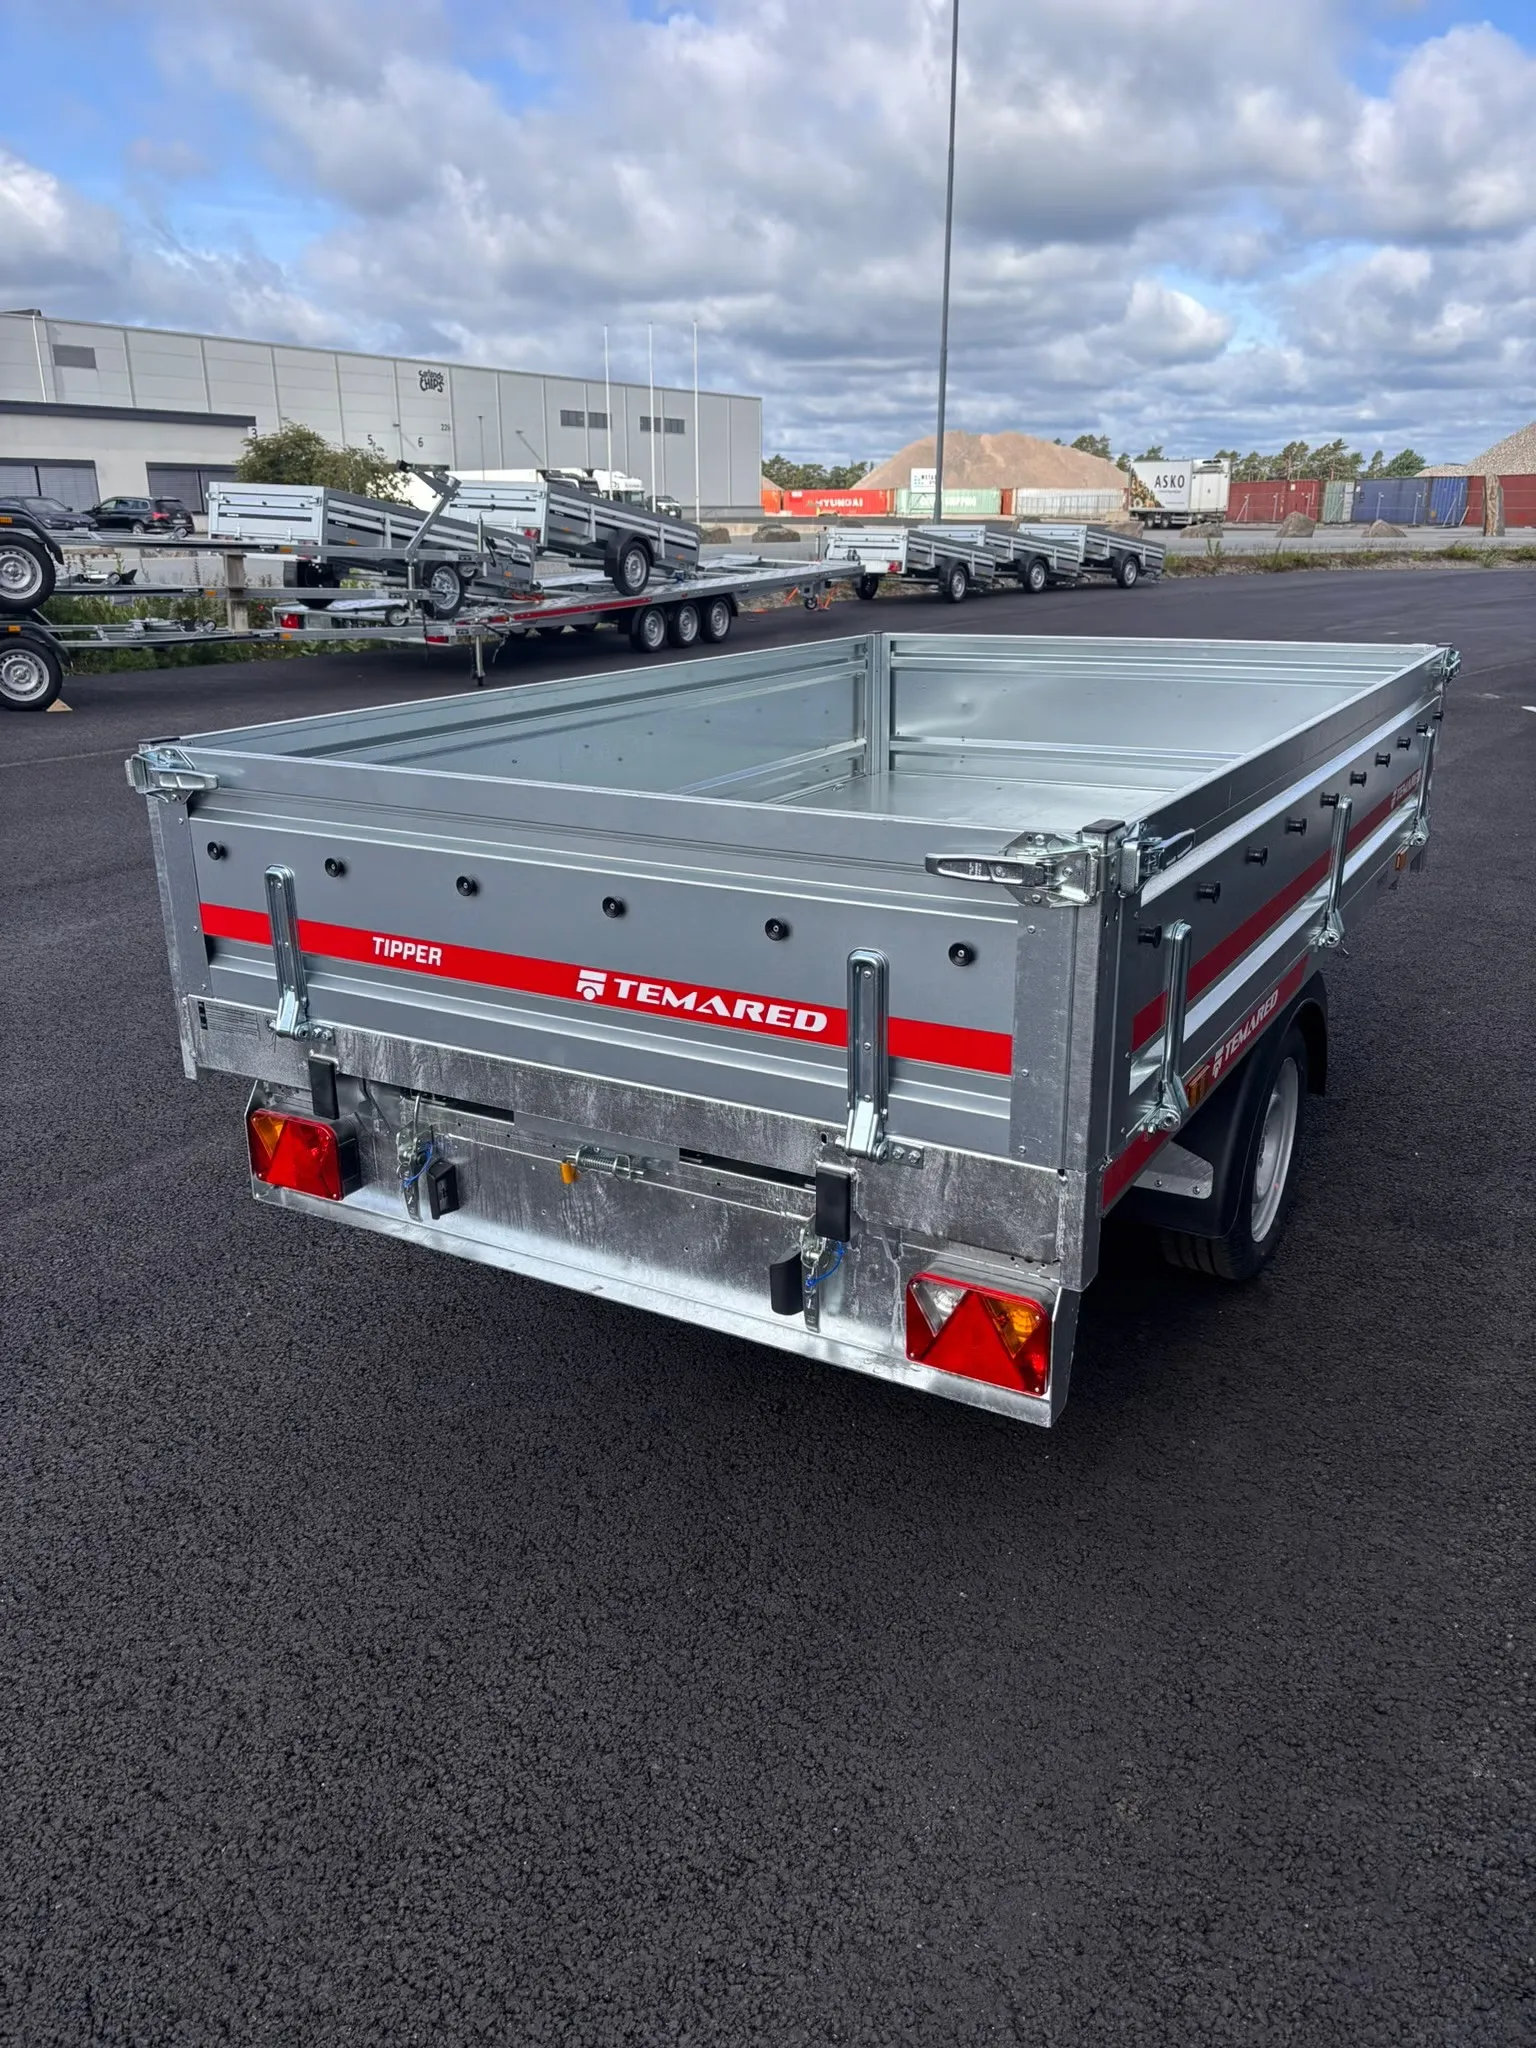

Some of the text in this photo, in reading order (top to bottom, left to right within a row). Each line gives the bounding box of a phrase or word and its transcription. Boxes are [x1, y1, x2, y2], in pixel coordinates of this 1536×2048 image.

[420, 377, 445, 393] CHIPS
[251, 428, 258, 440] 3
[367, 434, 374, 445] 5
[417, 436, 424, 448] 6
[1154, 474, 1186, 489] ASKO
[815, 497, 864, 507] HYUNDAI
[372, 936, 443, 967] TIPPER
[613, 977, 829, 1033] TEMARED
[1225, 988, 1279, 1061] TEMARED
